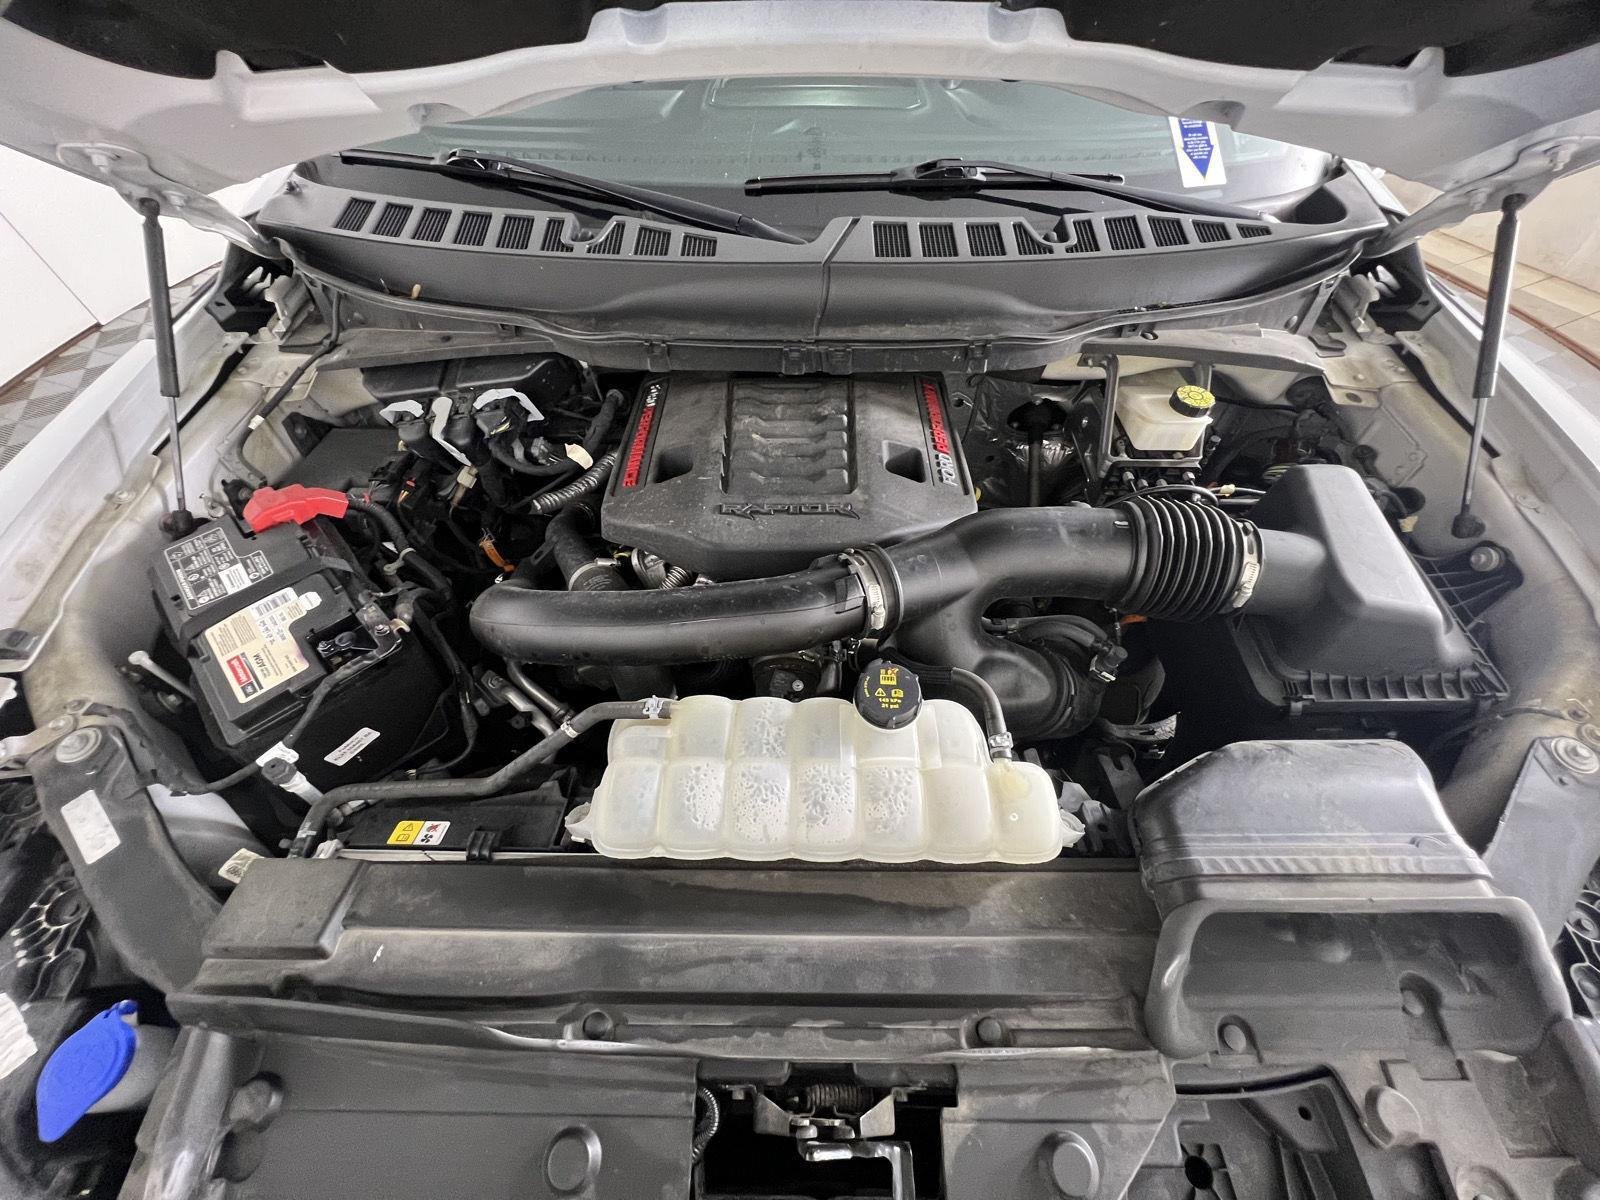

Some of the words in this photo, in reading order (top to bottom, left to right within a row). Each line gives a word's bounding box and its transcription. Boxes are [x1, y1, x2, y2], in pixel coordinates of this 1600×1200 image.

[938, 453, 959, 487] FORD
[719, 502, 861, 521] RAPTOR
[253, 652, 267, 668] AGM
